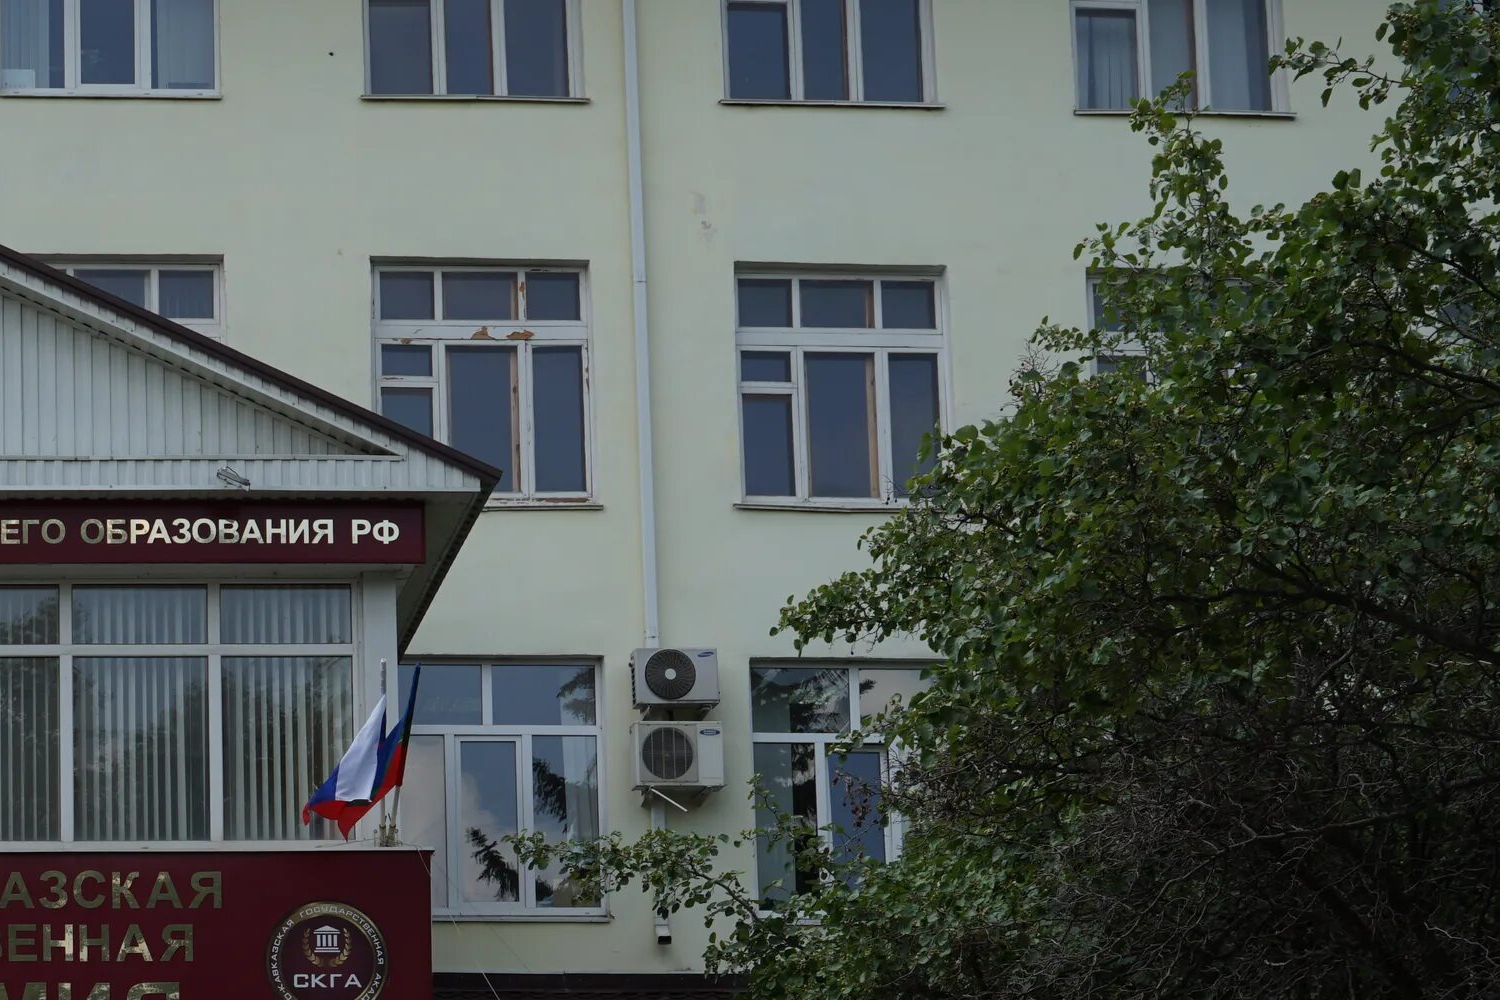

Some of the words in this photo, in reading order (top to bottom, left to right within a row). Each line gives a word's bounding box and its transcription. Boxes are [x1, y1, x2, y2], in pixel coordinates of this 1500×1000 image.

[79, 518, 334, 545] ОБРАЗОВАНИЯ
[351, 518, 399, 545] РФ
[299, 905, 384, 965] ГОСУДАРСТВЕННАЯ
[293, 973, 362, 988] СКГА
